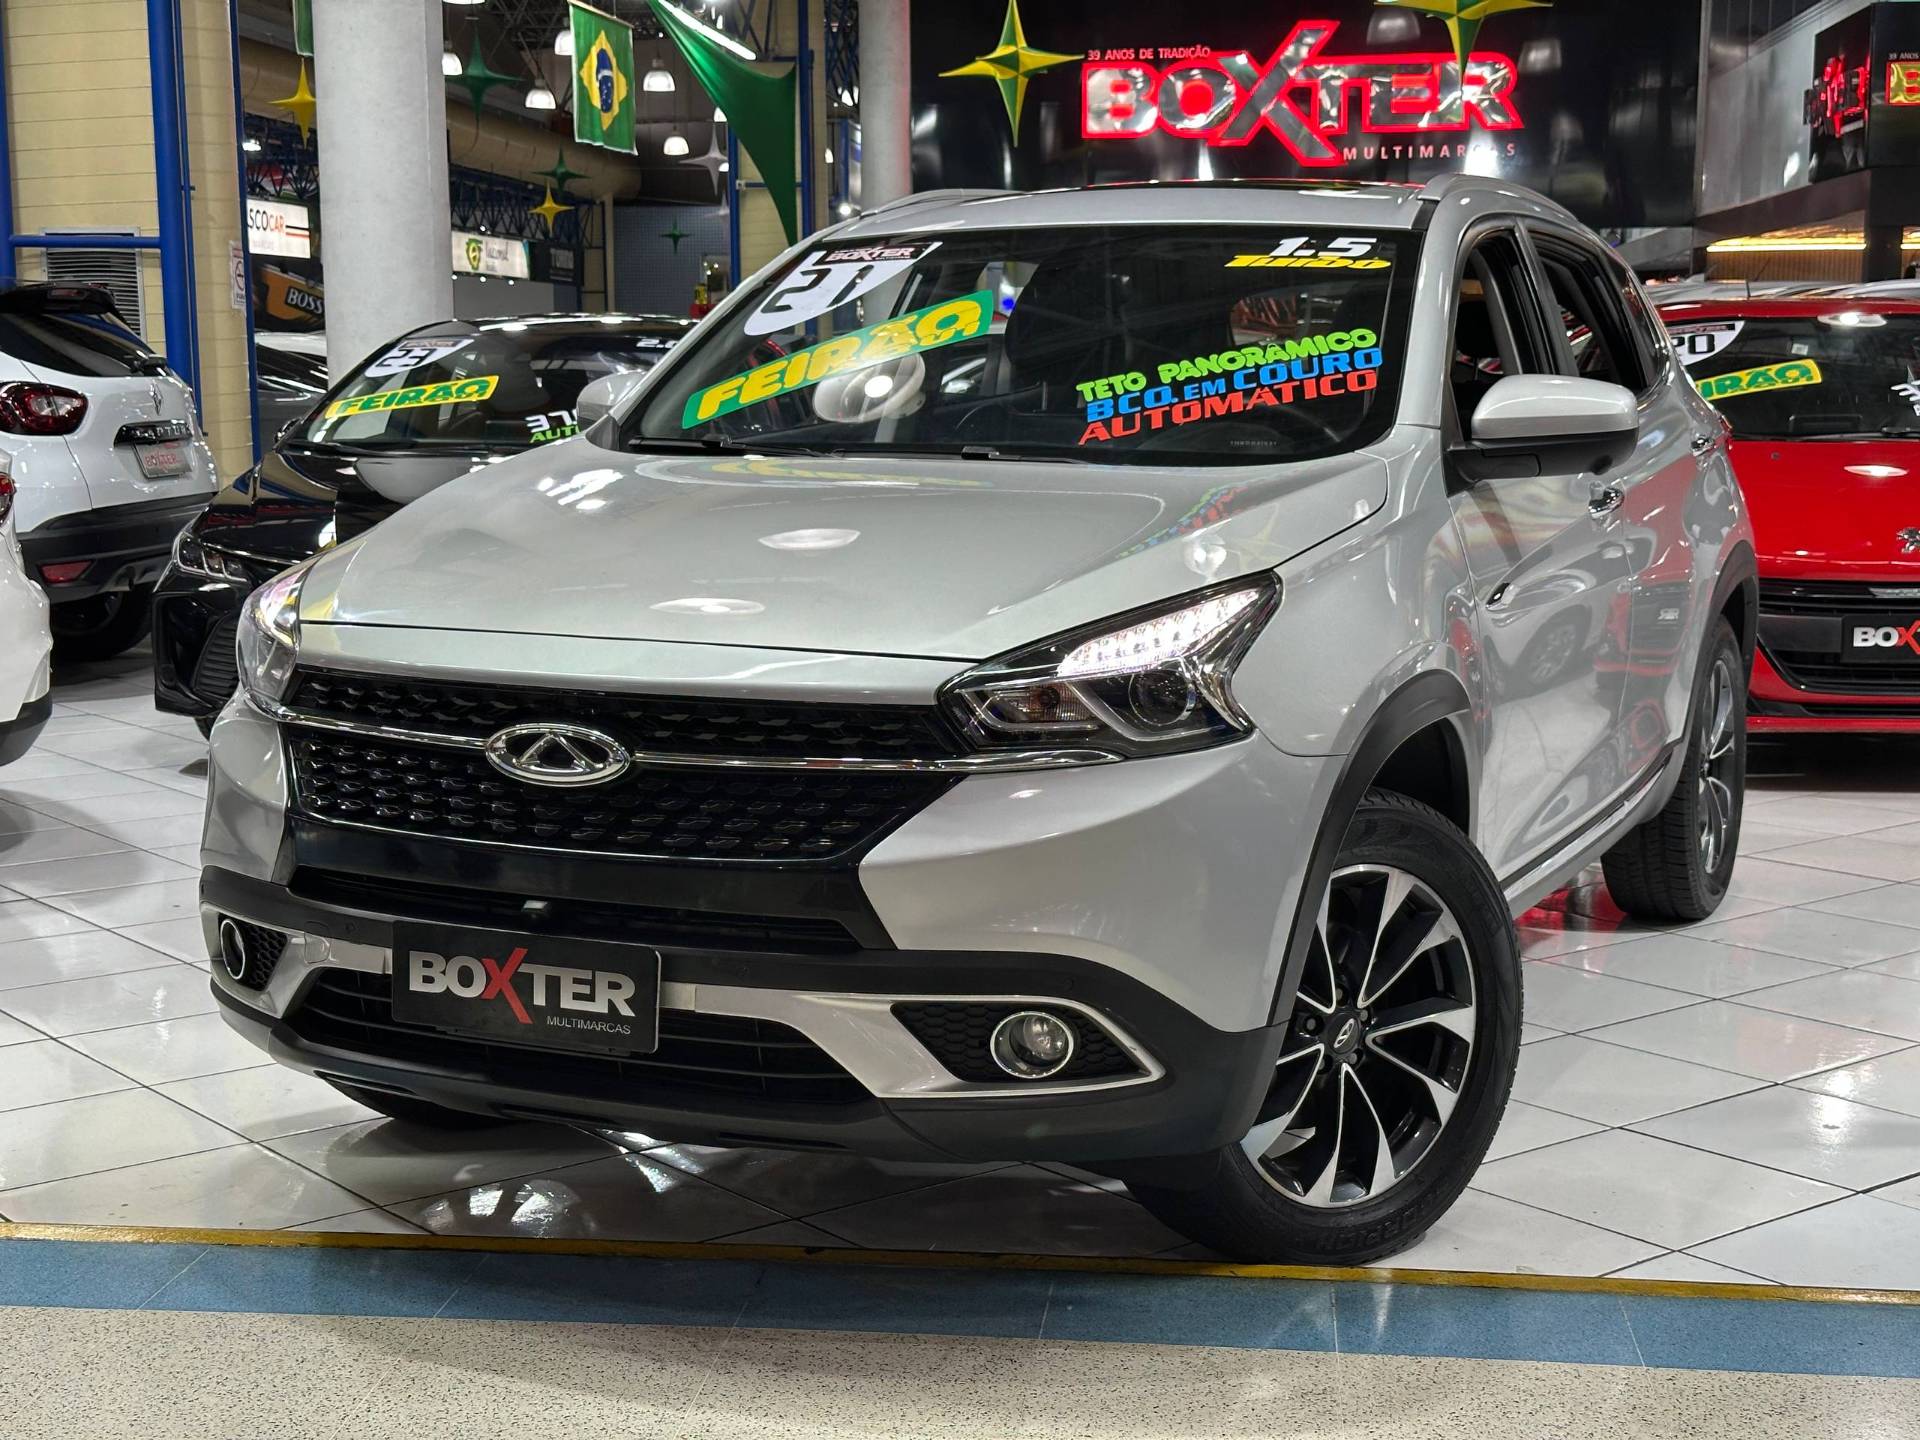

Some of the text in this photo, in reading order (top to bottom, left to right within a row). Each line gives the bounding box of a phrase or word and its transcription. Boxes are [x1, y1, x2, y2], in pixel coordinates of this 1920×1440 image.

[1087, 44, 1211, 60] 39 ANOS DE TRADIÇÃO
[1081, 20, 1524, 167] BOXTER
[1343, 143, 1516, 160] MULTIMARCAS
[825, 245, 916, 262] BOXTER
[1270, 237, 1377, 257] 1.5
[287, 288, 323, 314] BOSS
[761, 264, 874, 313] 21
[697, 300, 982, 420] FEIRÃO
[1076, 328, 1377, 402] TETO PANORÂMICO
[1184, 378, 1226, 399] EM
[1233, 348, 1383, 390] COURO
[336, 379, 491, 414] FEIRÃO
[1078, 369, 1378, 446] AUTOMÁTICO
[529, 425, 580, 443] AUT
[1853, 620, 1920, 655] BOX
[408, 947, 637, 1025] BOXTER
[546, 1015, 632, 1035] MULTIMARCAS
